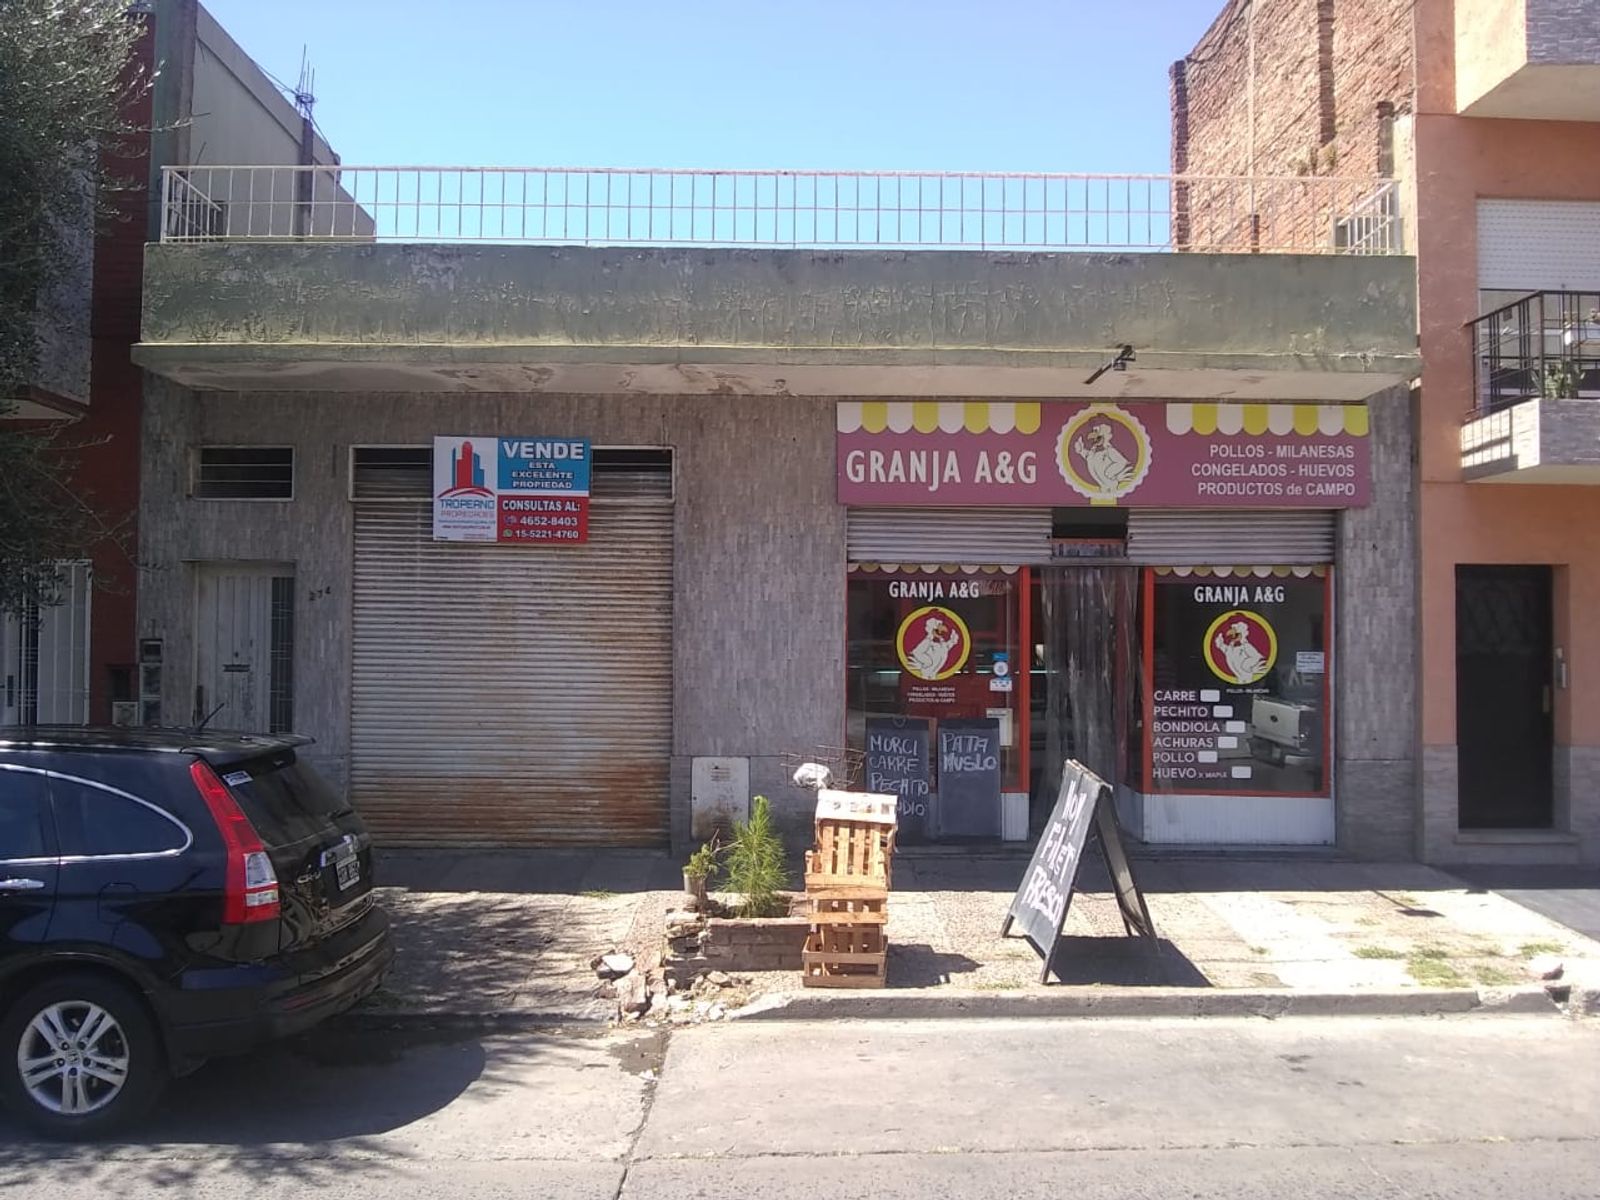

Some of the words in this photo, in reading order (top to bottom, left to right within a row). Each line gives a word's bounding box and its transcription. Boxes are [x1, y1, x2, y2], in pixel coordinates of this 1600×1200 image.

[503, 441, 584, 459] VENDE
[1210, 445, 1265, 458] POLLOS
[1276, 446, 1355, 458] MILANESAS
[512, 471, 573, 479] EXCELENTE
[846, 450, 961, 491] GRANJA
[974, 451, 1037, 484] A&G
[1191, 463, 1287, 476] CONGELADOS
[1299, 464, 1355, 476] HUEVOS
[512, 481, 572, 489] PROPIEDAD
[1198, 482, 1283, 495] PRODUCTOS
[1287, 482, 1302, 495] de
[1306, 483, 1356, 496] CAMPO
[502, 500, 562, 511] CONSULTAS
[888, 581, 944, 602] GRANJA
[949, 581, 980, 598] A&G
[1194, 586, 1249, 606] GRANJA
[1253, 586, 1285, 602] A&G
[1153, 690, 1196, 701] CARRE
[1153, 706, 1208, 717] PECHITO
[1153, 721, 1220, 733] BONDIOLA
[942, 732, 989, 754] PATA
[1153, 737, 1214, 748] ACHURAS
[943, 752, 997, 773] MUSLO
[1152, 752, 1195, 763] POLLO
[869, 755, 920, 775] CARRE
[1152, 768, 1197, 778] HUEVO
